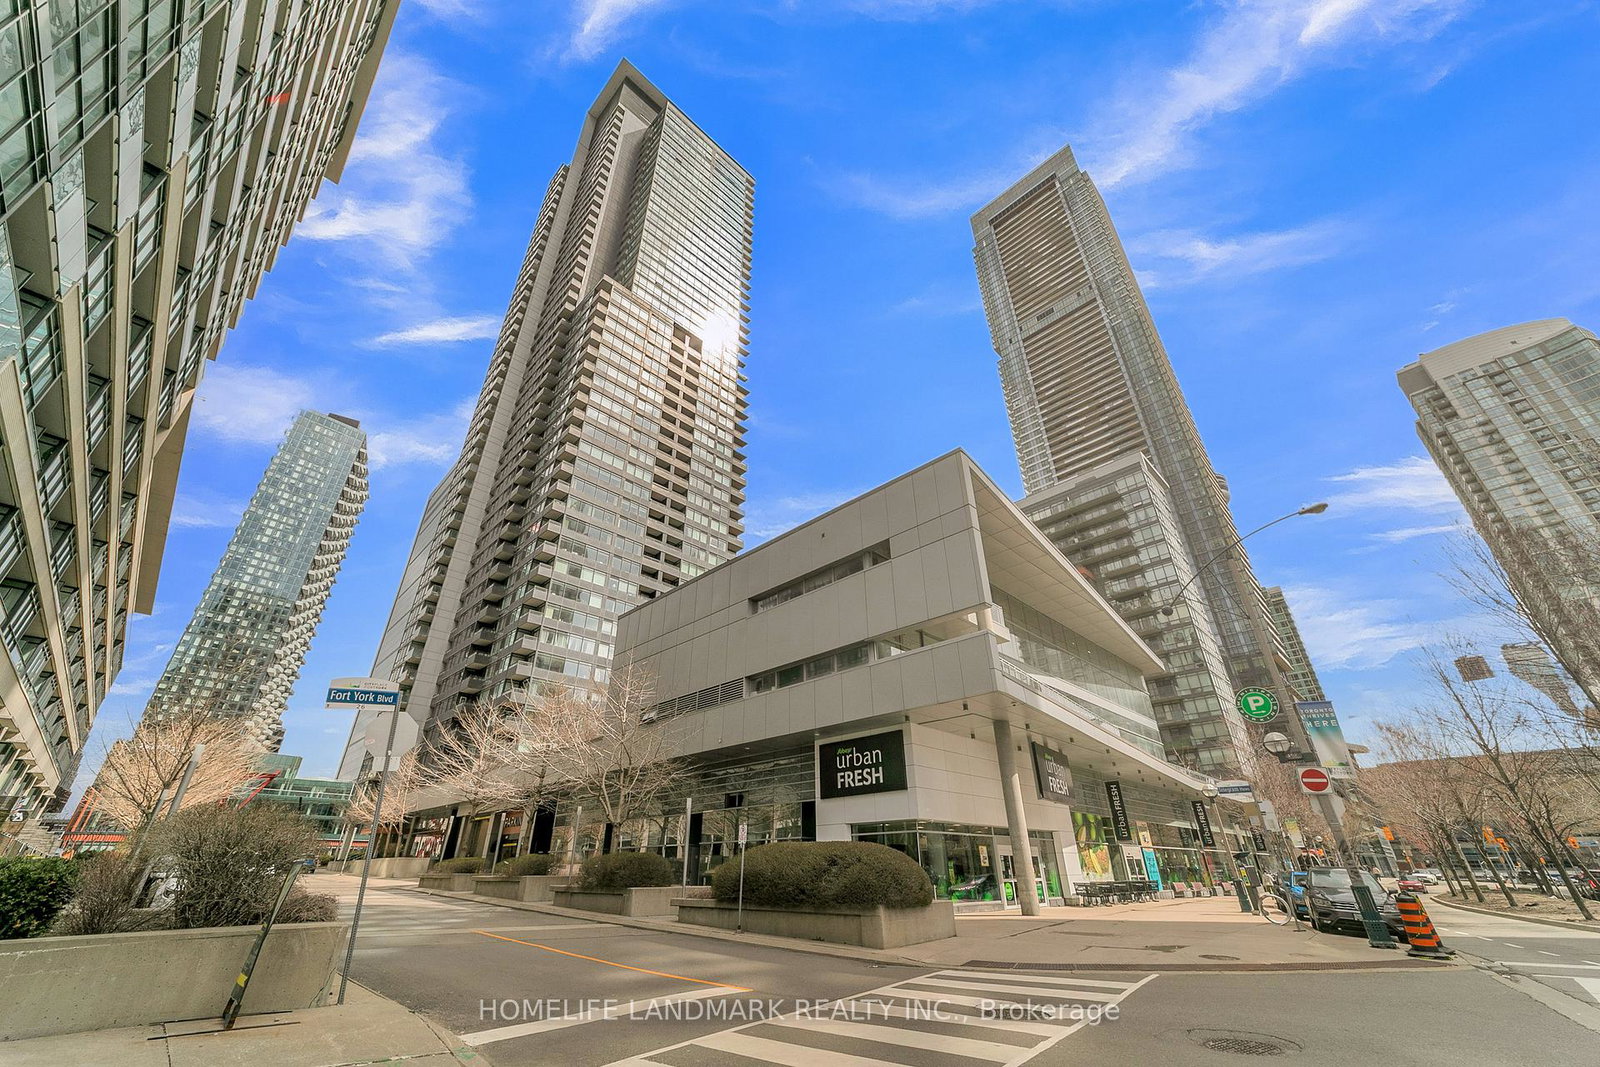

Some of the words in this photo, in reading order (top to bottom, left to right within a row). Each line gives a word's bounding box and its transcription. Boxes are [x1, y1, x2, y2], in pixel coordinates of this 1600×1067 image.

[330, 690, 351, 701] Fort
[354, 691, 375, 702] York
[377, 694, 394, 703] Blvd
[1246, 696, 1265, 711] P
[1304, 719, 1338, 728] HERE
[836, 747, 882, 769] urban
[1045, 757, 1066, 777] urban
[837, 766, 884, 789] FRESH
[1048, 776, 1070, 796] FRESH
